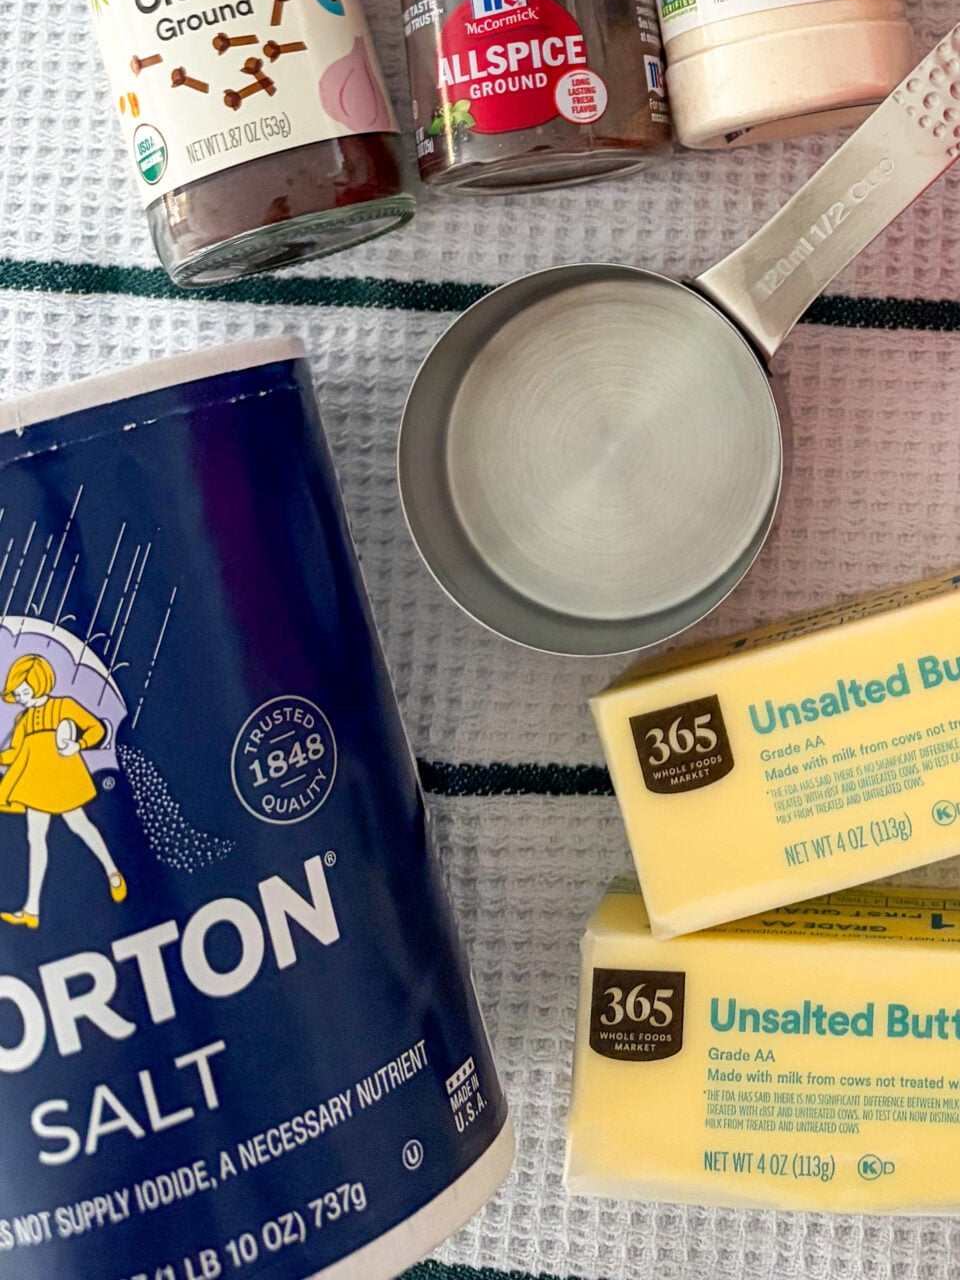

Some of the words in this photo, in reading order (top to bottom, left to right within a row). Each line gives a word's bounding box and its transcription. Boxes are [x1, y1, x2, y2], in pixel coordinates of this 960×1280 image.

[409, 0, 436, 17] TASTE
[465, 8, 539, 36] McCormick
[437, 35, 586, 88] ALLSPICE
[572, 78, 590, 86] LONG
[469, 73, 548, 100] GROUND
[568, 87, 596, 96] LASTING
[572, 96, 594, 104] FRESH
[572, 105, 597, 114] FLAVOR
[138, 137, 155, 156] USDA
[186, 142, 208, 165] NET
[206, 136, 222, 158] WT
[223, 128, 244, 154] 1.87
[245, 124, 260, 144] OZ
[261, 112, 291, 142] (53g)
[810, 201, 851, 244] 1/2
[748, 663, 911, 734] Unsalted
[244, 707, 315, 757] TRUSTED
[644, 713, 717, 766] 365
[760, 742, 800, 762] Grade
[804, 735, 826, 750] AA
[765, 762, 800, 781] Made
[802, 757, 828, 772] with
[832, 746, 857, 767] milk
[860, 738, 888, 756] from
[891, 732, 922, 749] cows
[925, 724, 946, 739] not
[248, 733, 325, 788] 1848
[653, 763, 687, 779] WHOLE
[690, 754, 723, 769] FOODS
[670, 768, 711, 786] MARKET
[262, 769, 327, 813] QUALITY
[784, 842, 811, 867] NET
[812, 835, 834, 859] WT
[837, 832, 846, 852] 4
[849, 826, 868, 849] OZ
[870, 815, 913, 847] (113g)
[601, 983, 674, 1027] 365
[710, 999, 873, 1039] Unsalted
[30, 1041, 226, 1165] SALT
[450, 1080, 472, 1112] MADE
[471, 1074, 480, 1095] IN
[454, 1096, 487, 1133] U.S.A.
[17, 1211, 53, 1242] NOT
[56, 1189, 131, 1235] SUPPLY
[134, 1160, 219, 1209] IODIDE,
[219, 1150, 237, 1177] A
[238, 1090, 353, 1171] NECESSARY
[357, 1039, 429, 1107] NUTRIENT
[225, 1235, 259, 1267] 10
[261, 1210, 307, 1253] OZ)
[308, 1181, 368, 1229] 737g
